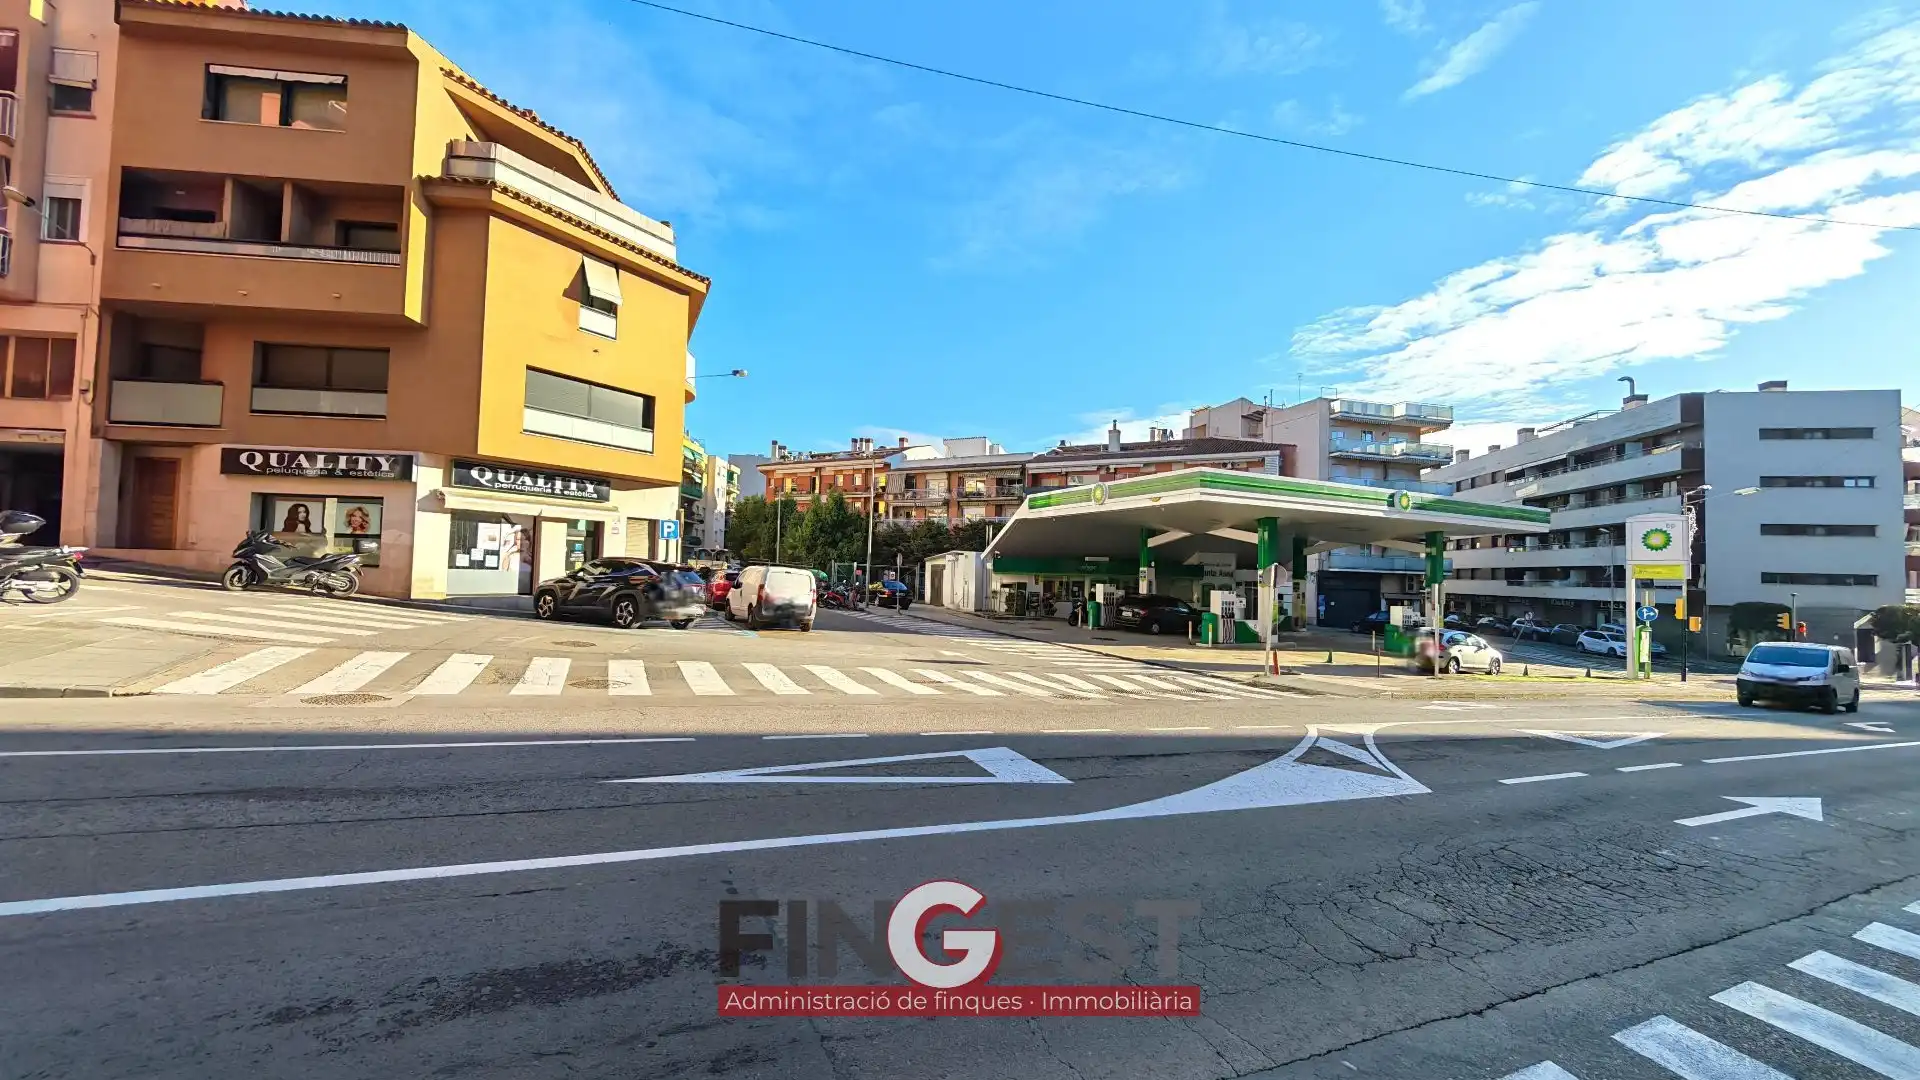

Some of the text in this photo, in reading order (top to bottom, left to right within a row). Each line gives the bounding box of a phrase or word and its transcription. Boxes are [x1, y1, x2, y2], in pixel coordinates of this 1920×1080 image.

[239, 451, 395, 471] QUALITY
[470, 466, 598, 492] QUALITY
[664, 521, 675, 538] P
